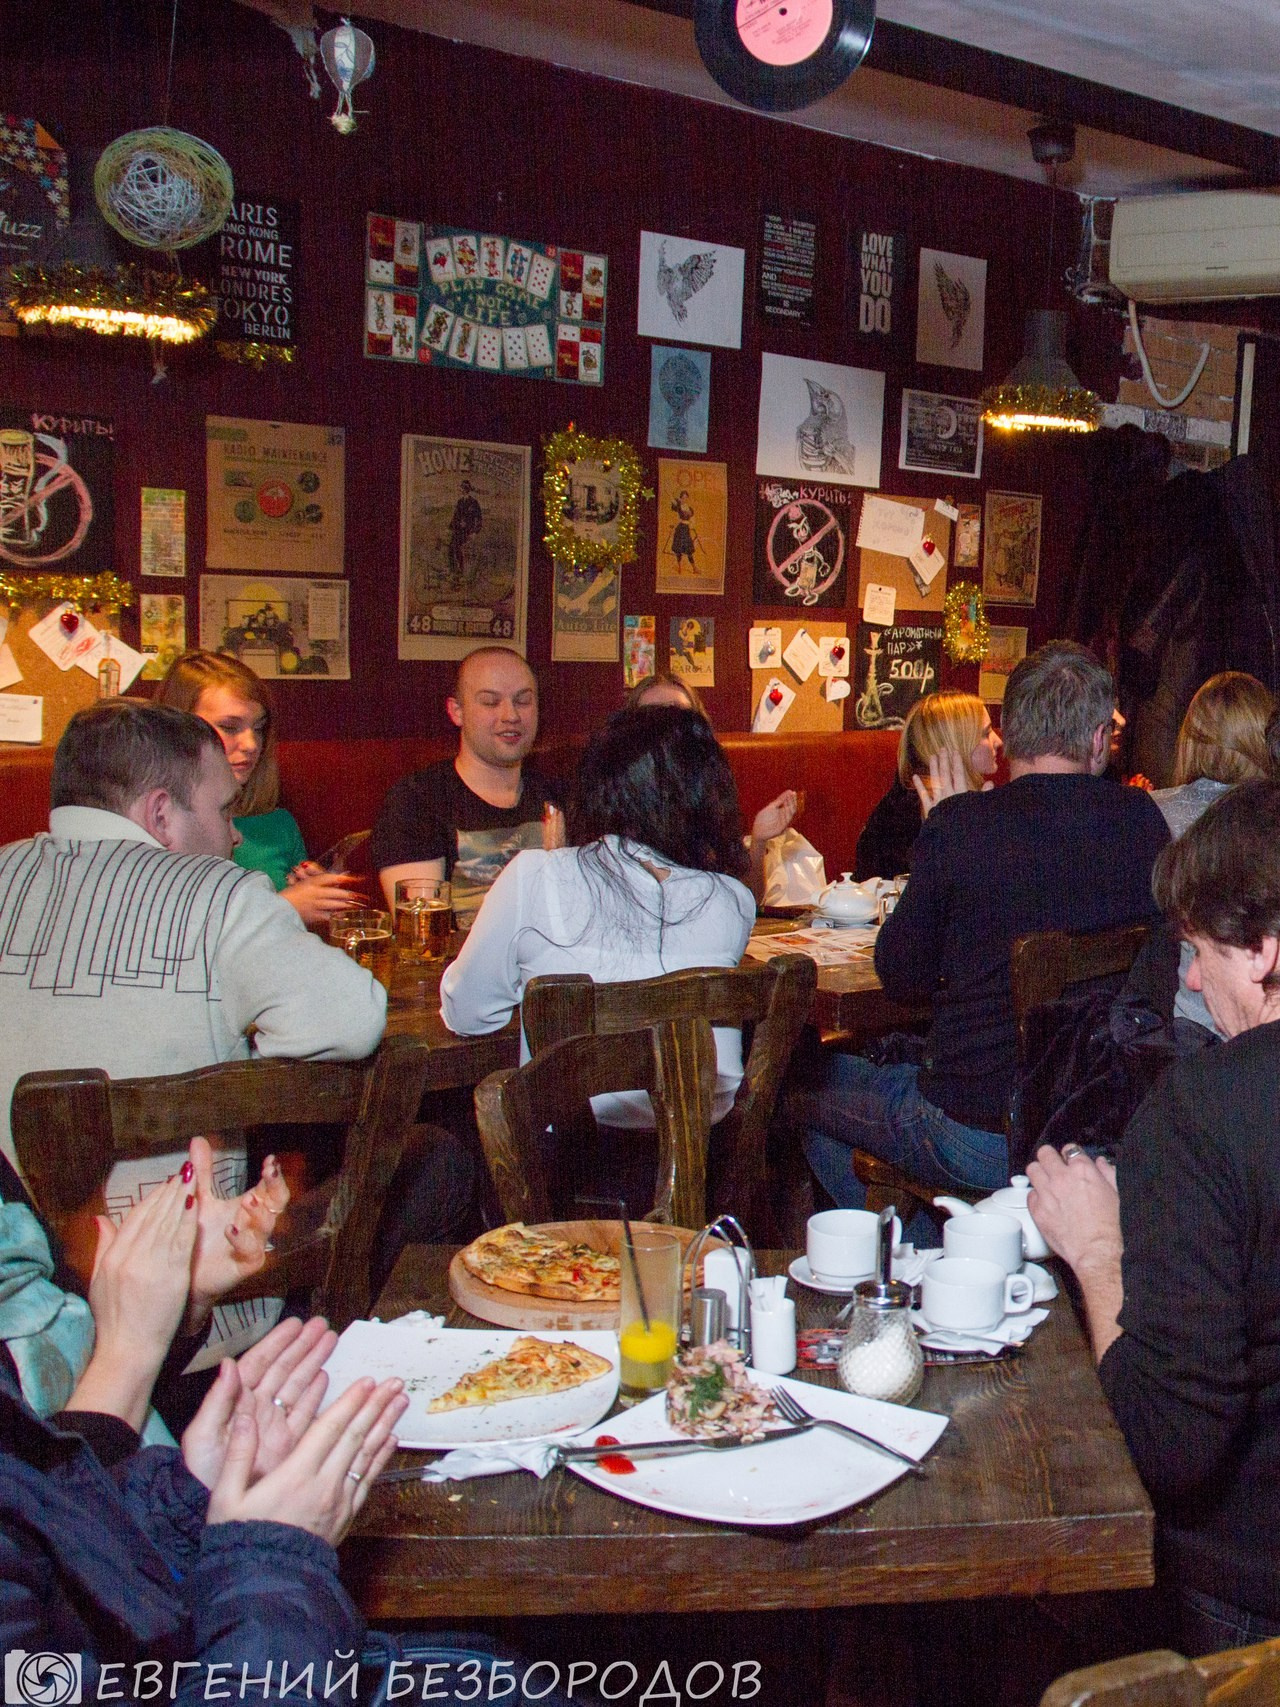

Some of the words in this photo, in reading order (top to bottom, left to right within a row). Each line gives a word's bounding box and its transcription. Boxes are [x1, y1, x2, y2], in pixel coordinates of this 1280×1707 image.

[220, 235, 292, 268] ROME
[862, 231, 894, 258] LOVE
[861, 252, 893, 274] WHAT
[254, 269, 287, 285] YORK
[861, 268, 893, 298] YOU
[211, 278, 292, 304] LONDRES
[496, 283, 541, 310] GAME
[464, 304, 512, 325] LIFE
[860, 293, 891, 334] DO
[244, 322, 291, 339] BERLIN
[418, 447, 470, 477] HOWE
[410, 615, 431, 632] 48
[493, 619, 512, 637] 48
